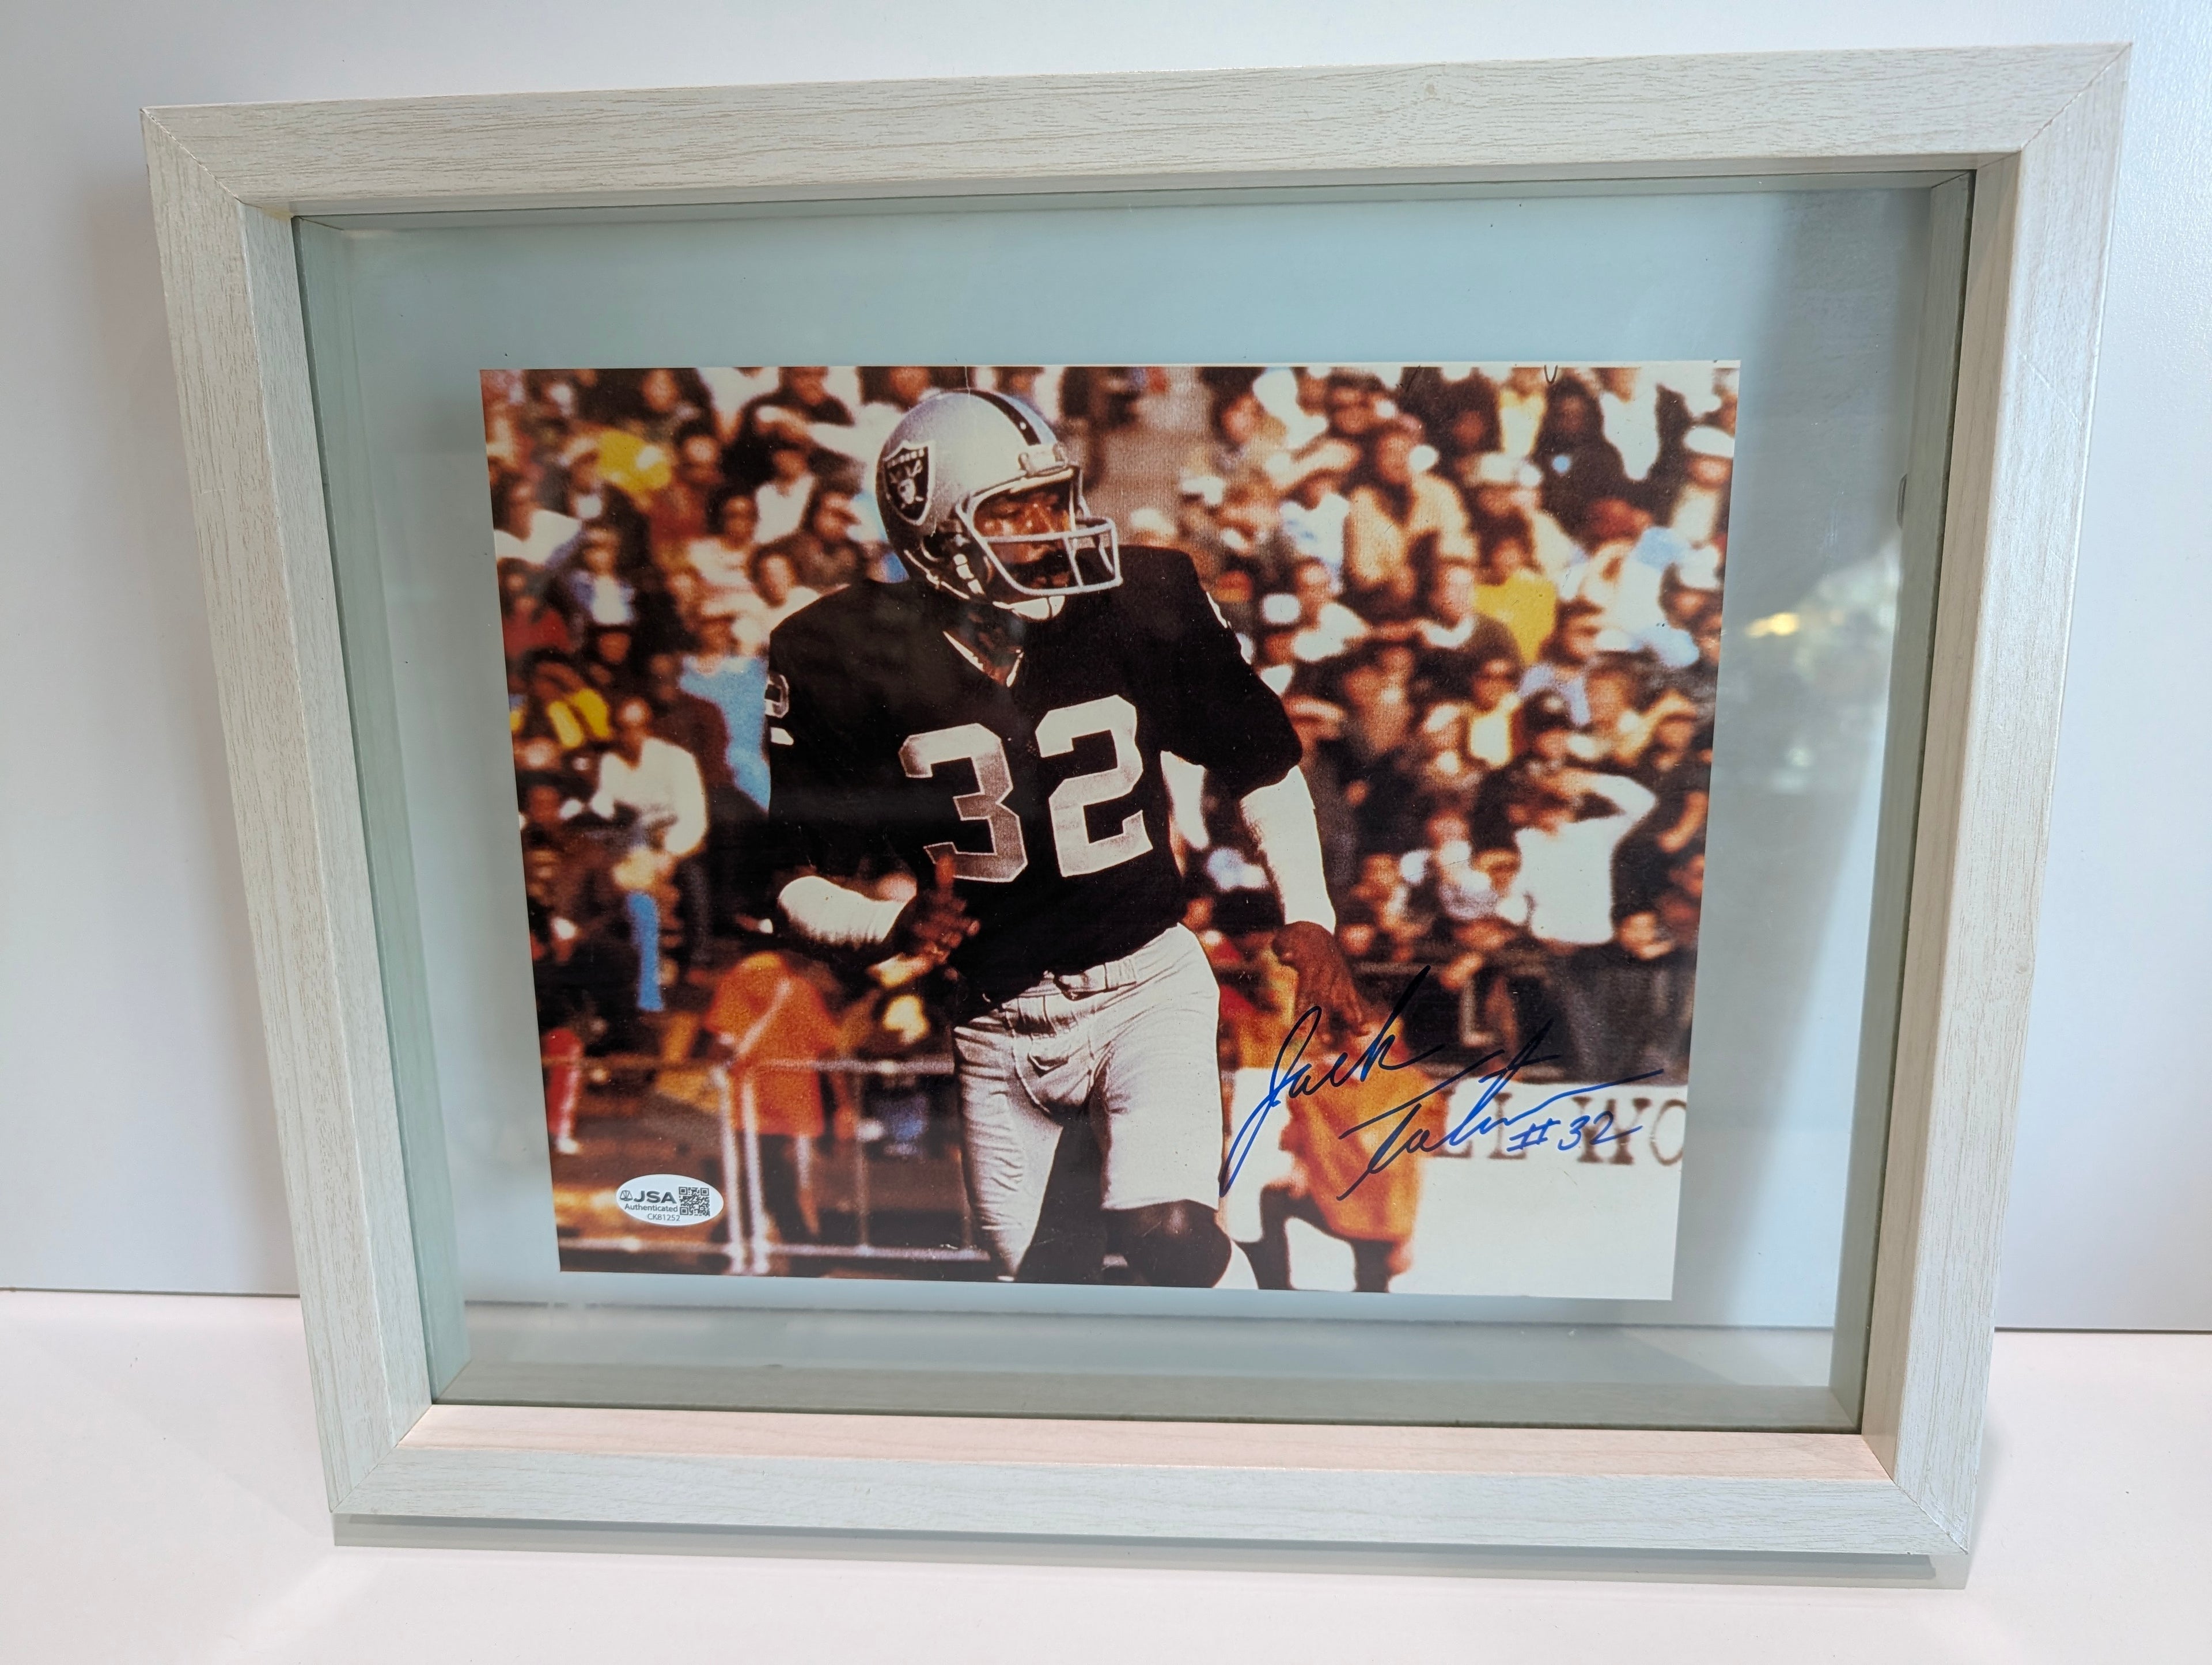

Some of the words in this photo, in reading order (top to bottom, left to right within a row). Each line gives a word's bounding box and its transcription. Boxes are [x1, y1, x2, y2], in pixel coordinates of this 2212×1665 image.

[899, 695, 1153, 882] 32
[1219, 965, 1446, 1198] Jack
[1506, 1110, 1643, 1152] #32
[624, 1203, 678, 1212] Authenticated
[634, 1190, 677, 1204] JSA
